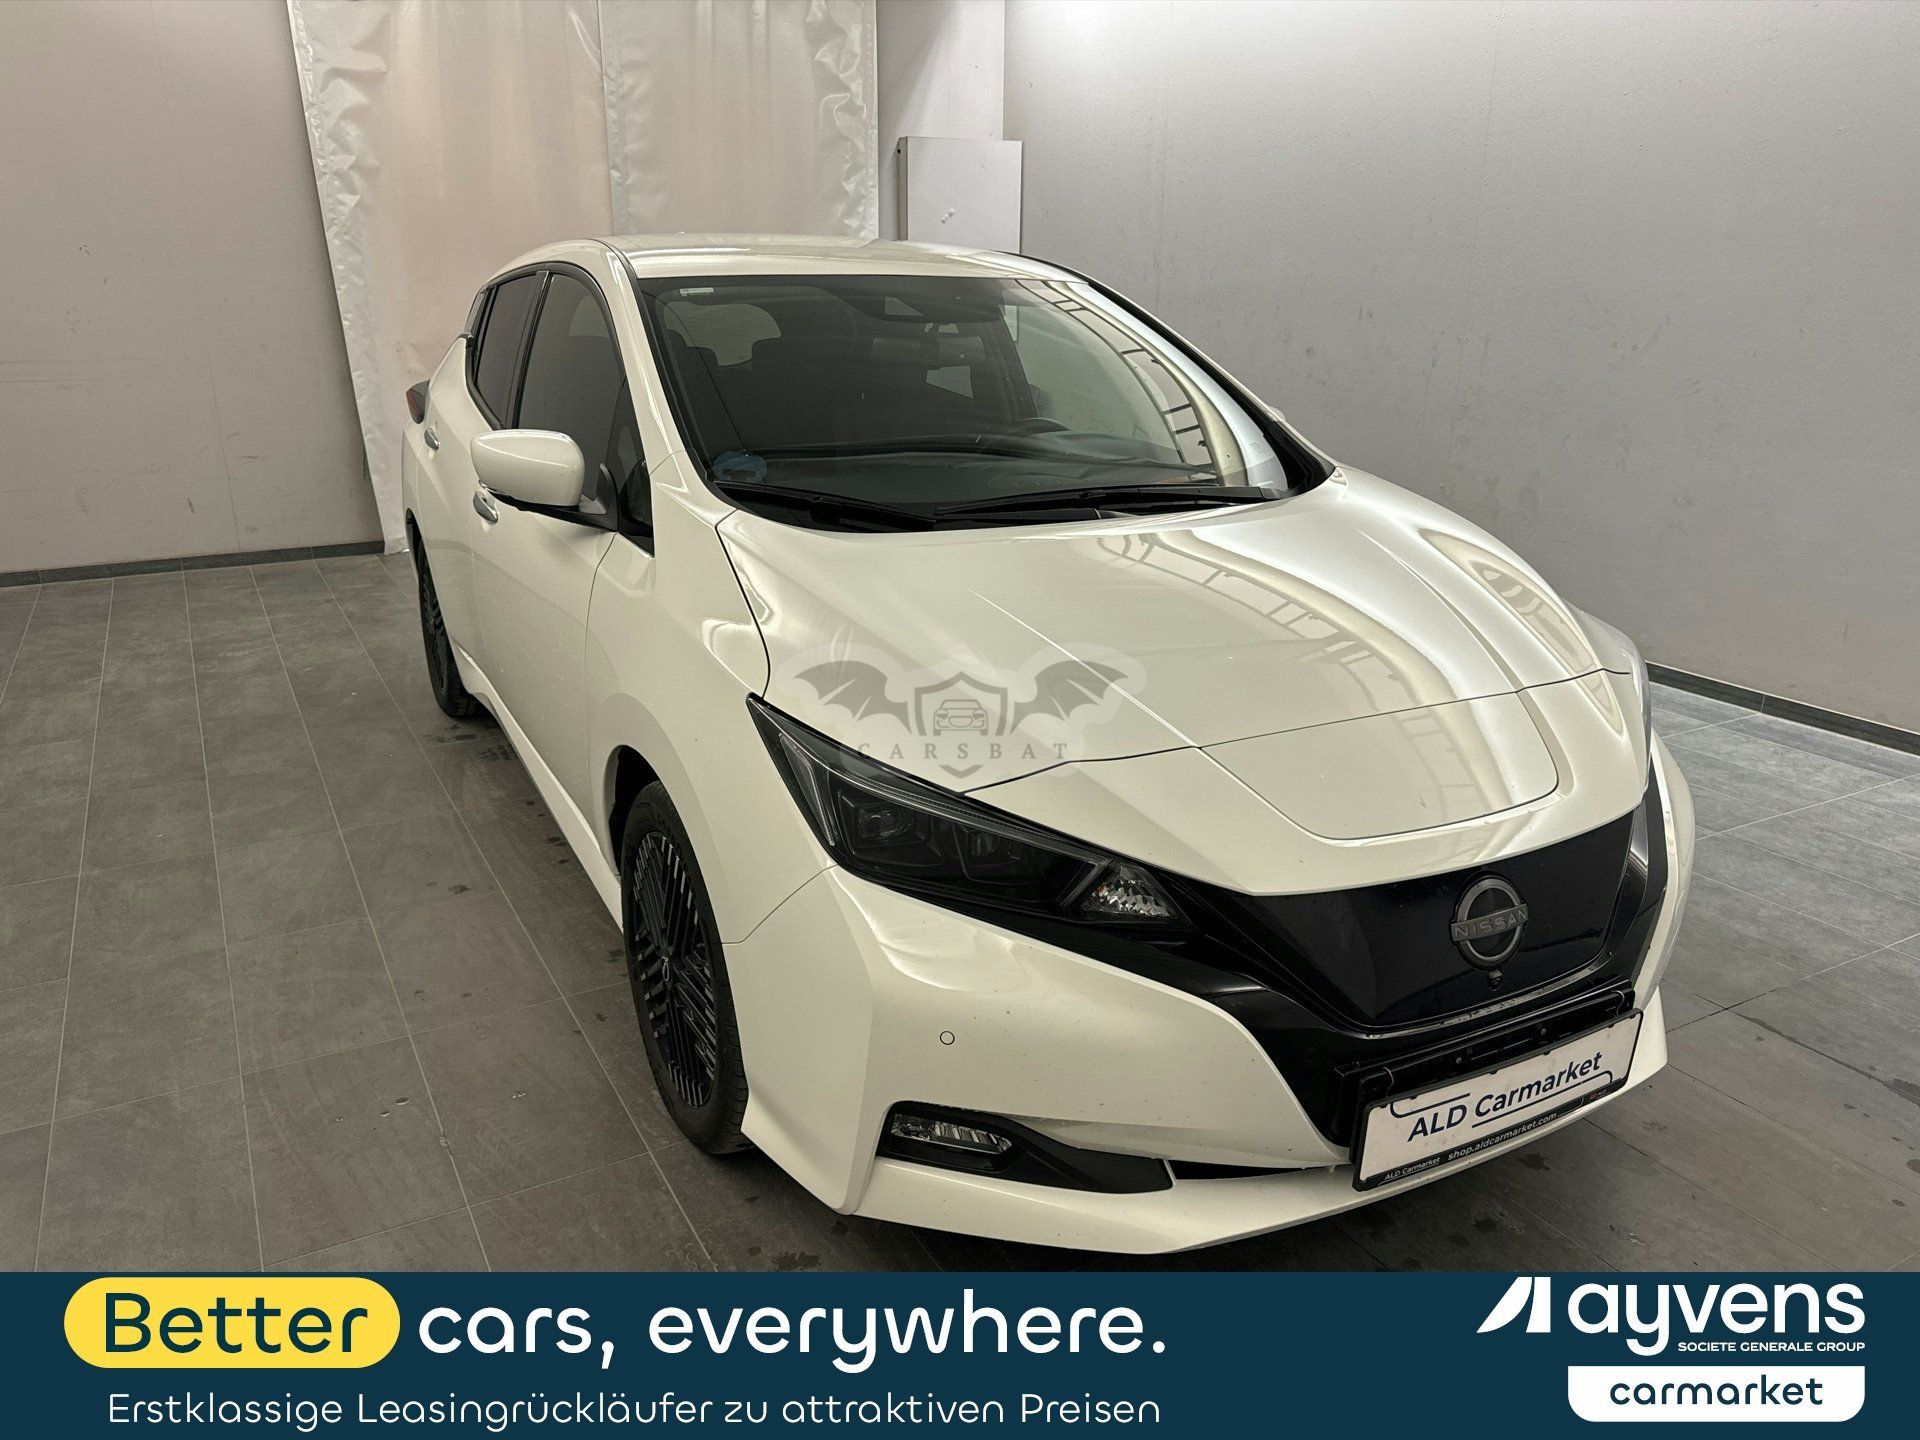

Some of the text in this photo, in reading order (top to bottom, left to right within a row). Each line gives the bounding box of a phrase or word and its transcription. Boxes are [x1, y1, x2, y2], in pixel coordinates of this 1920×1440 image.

[1455, 908, 1527, 937] NISSAN
[1407, 1051, 1603, 1143] ALD Carmarket
[1384, 1113, 1557, 1180] ALD Carmarket shop.aldcarmarket.com
